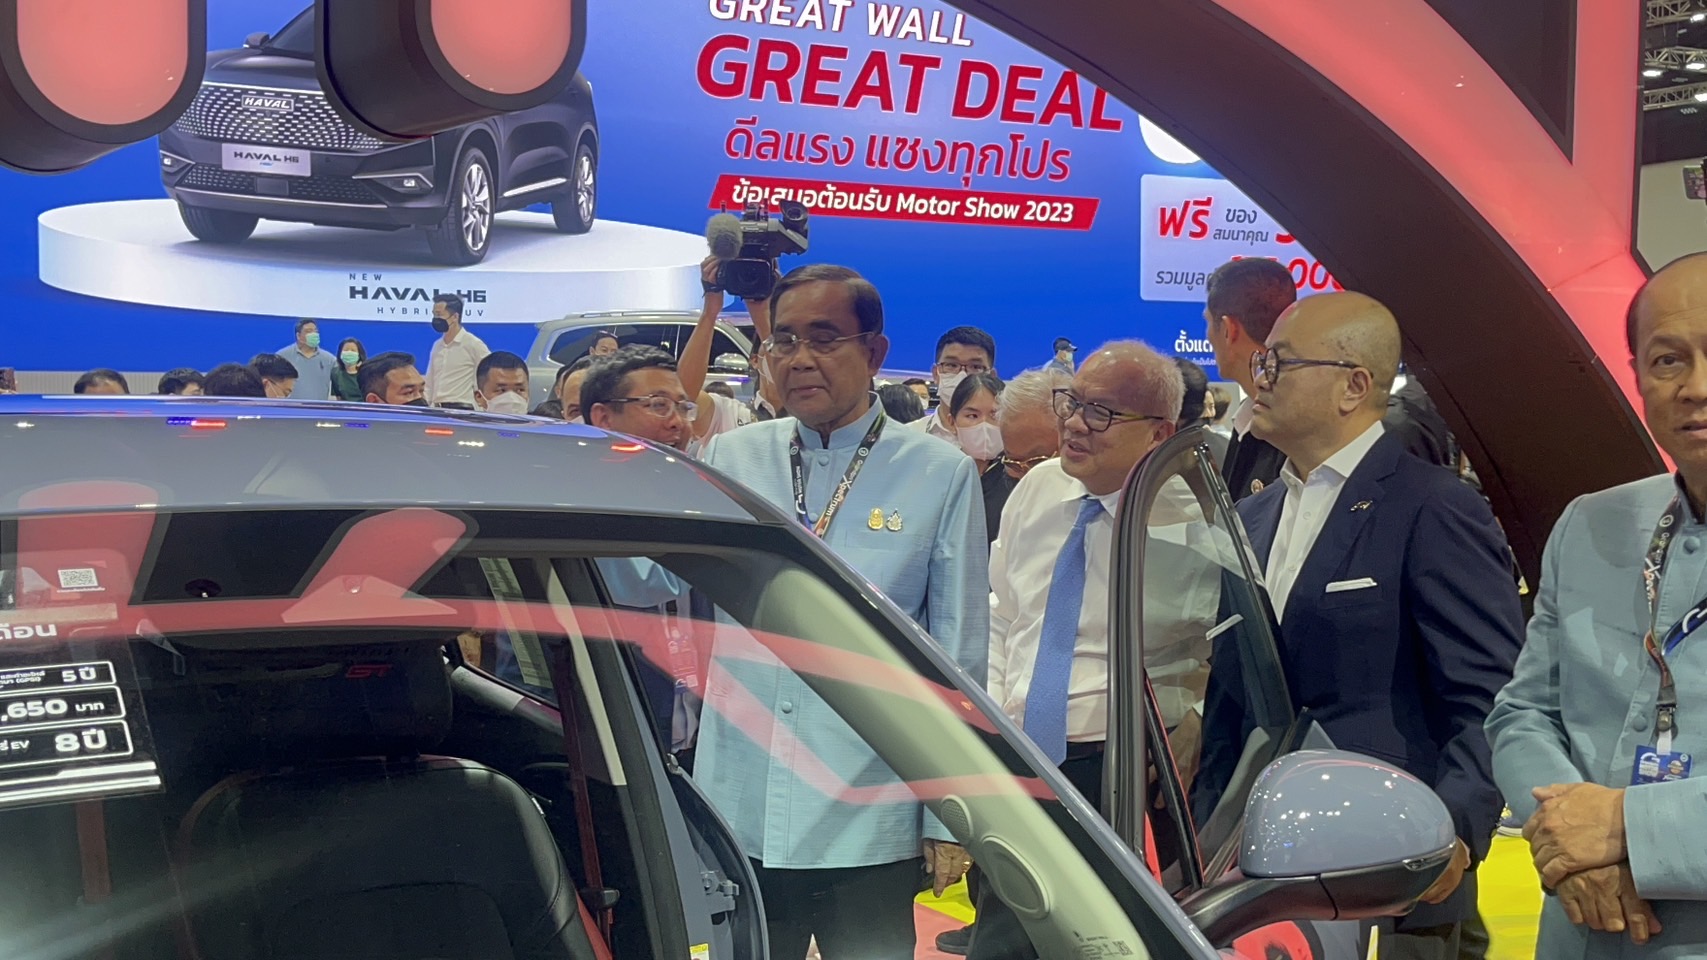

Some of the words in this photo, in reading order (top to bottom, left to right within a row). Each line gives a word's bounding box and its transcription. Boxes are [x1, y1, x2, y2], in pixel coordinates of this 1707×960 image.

[708, 0, 853, 32] GREAT
[866, 2, 974, 47] WALL
[696, 33, 942, 116] GREAT
[950, 59, 1123, 133] DEAL
[244, 97, 290, 109] HAVAL
[233, 151, 282, 163] HAVAL
[283, 155, 300, 164] H6
[724, 116, 857, 168] ดีลแรง
[864, 133, 1072, 189] แซงทุกโปร
[896, 193, 961, 217] Motor
[964, 197, 1019, 220] Show
[1023, 200, 1075, 223] 2023
[1225, 207, 1258, 224] ของ
[1158, 196, 1214, 240] ฟรี
[1213, 229, 1269, 246] สมนาคุณ
[349, 273, 383, 282] NEW
[376, 307, 428, 316] HYBRI
[1174, 329, 1214, 353] ตั้งแต
[75, 700, 105, 713] บาท
[10, 740, 30, 750] EV
[54, 733, 81, 752] 8
